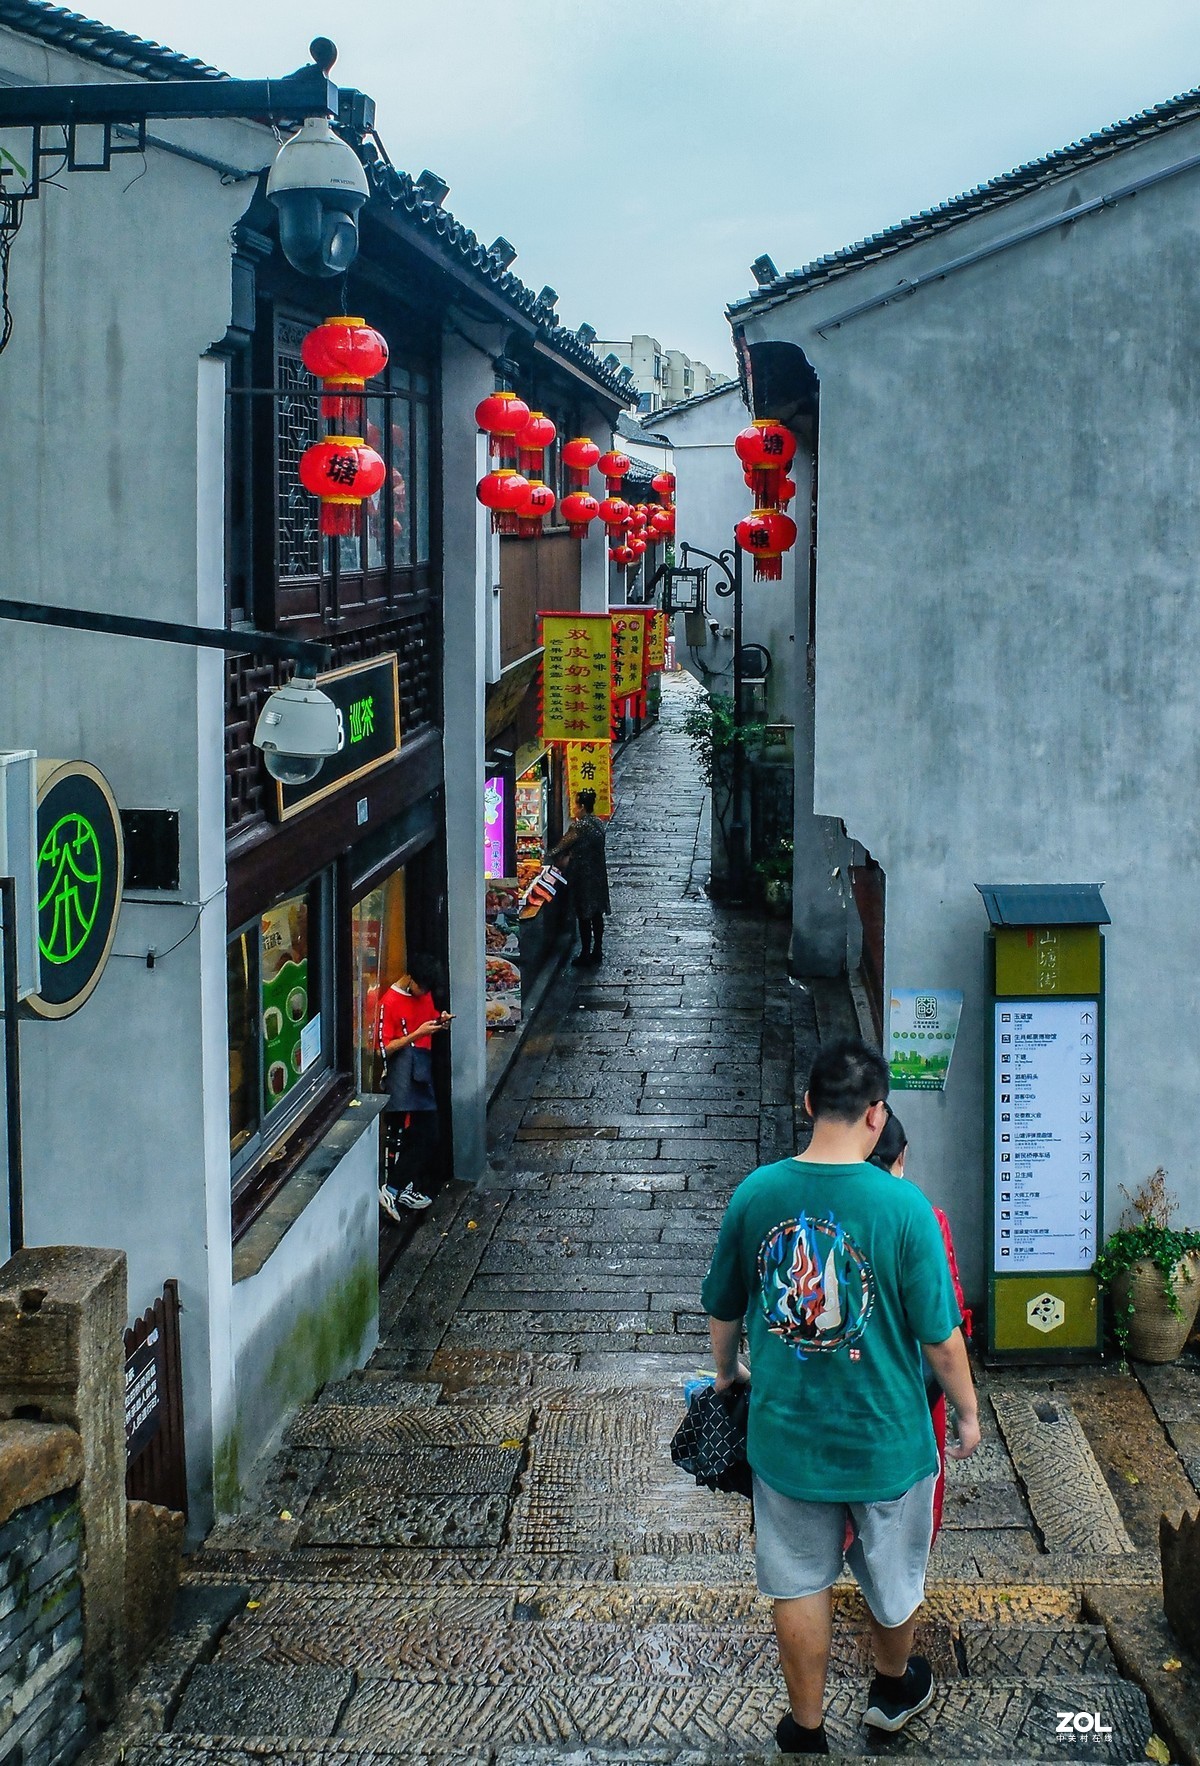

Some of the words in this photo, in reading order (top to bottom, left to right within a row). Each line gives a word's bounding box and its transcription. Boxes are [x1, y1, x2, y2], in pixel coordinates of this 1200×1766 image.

[763, 433, 784, 455] 塘
[326, 453, 358, 487] 塘
[531, 492, 546, 506] 山
[749, 528, 770, 549] 塘
[563, 629, 592, 731] 双皮奶冰淇淋
[349, 696, 375, 744] 巡茶
[1040, 930, 1057, 990] 山塘街
